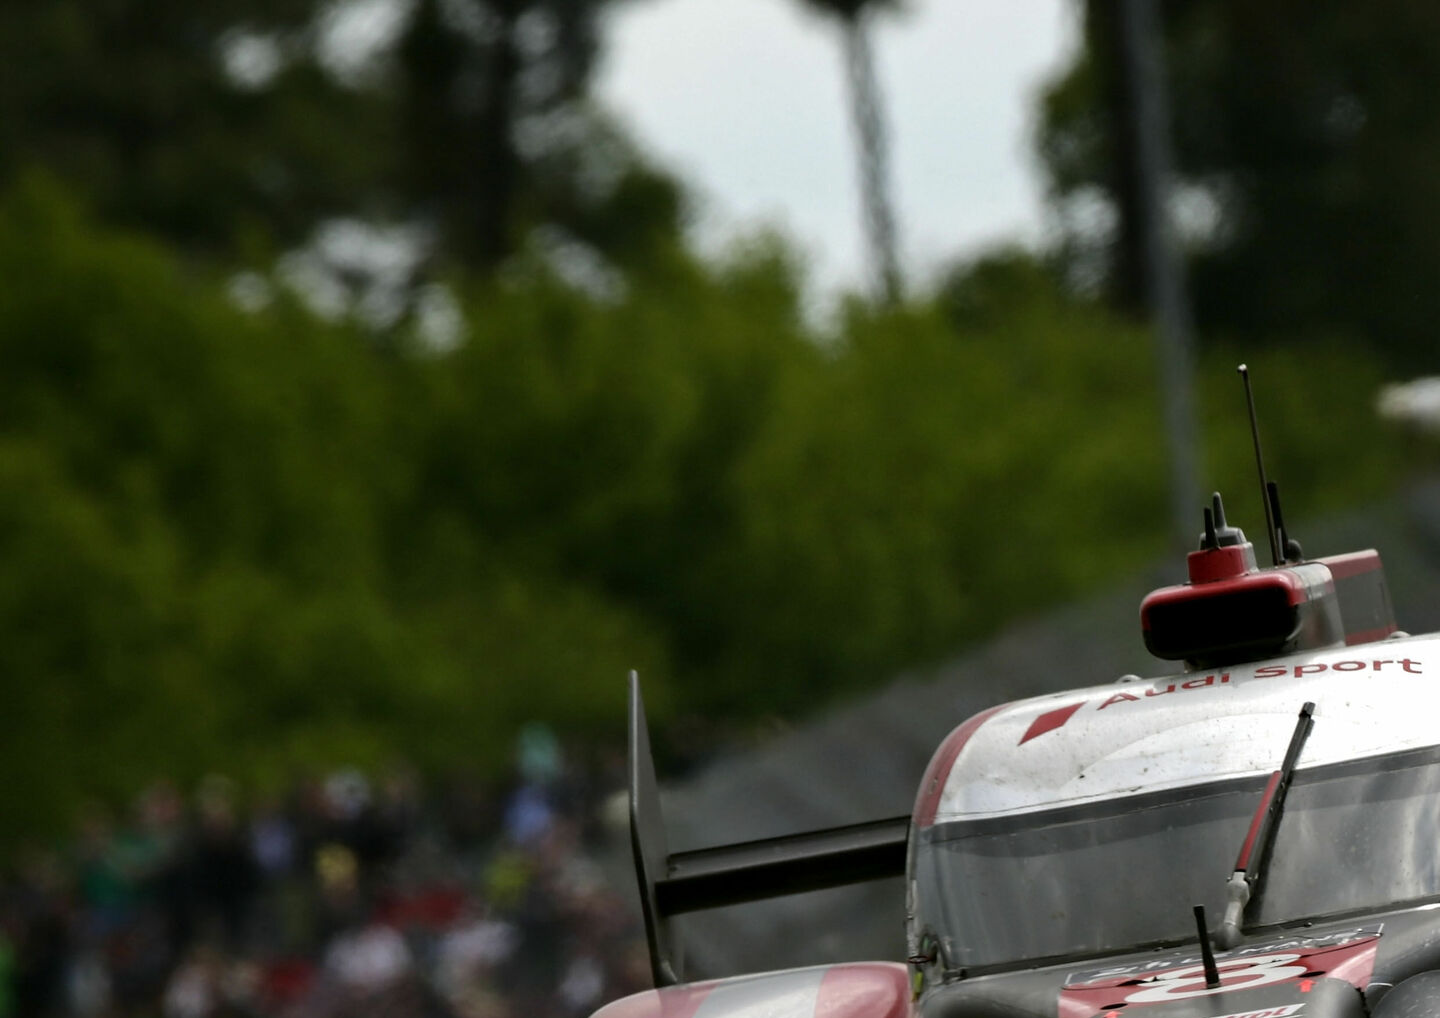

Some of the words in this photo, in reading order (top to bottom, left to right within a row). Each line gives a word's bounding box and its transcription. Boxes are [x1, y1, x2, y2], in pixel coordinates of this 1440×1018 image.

[1096, 672, 1230, 711] Audi
[1253, 657, 1423, 678] Sport
[1123, 953, 1308, 1003] 8
